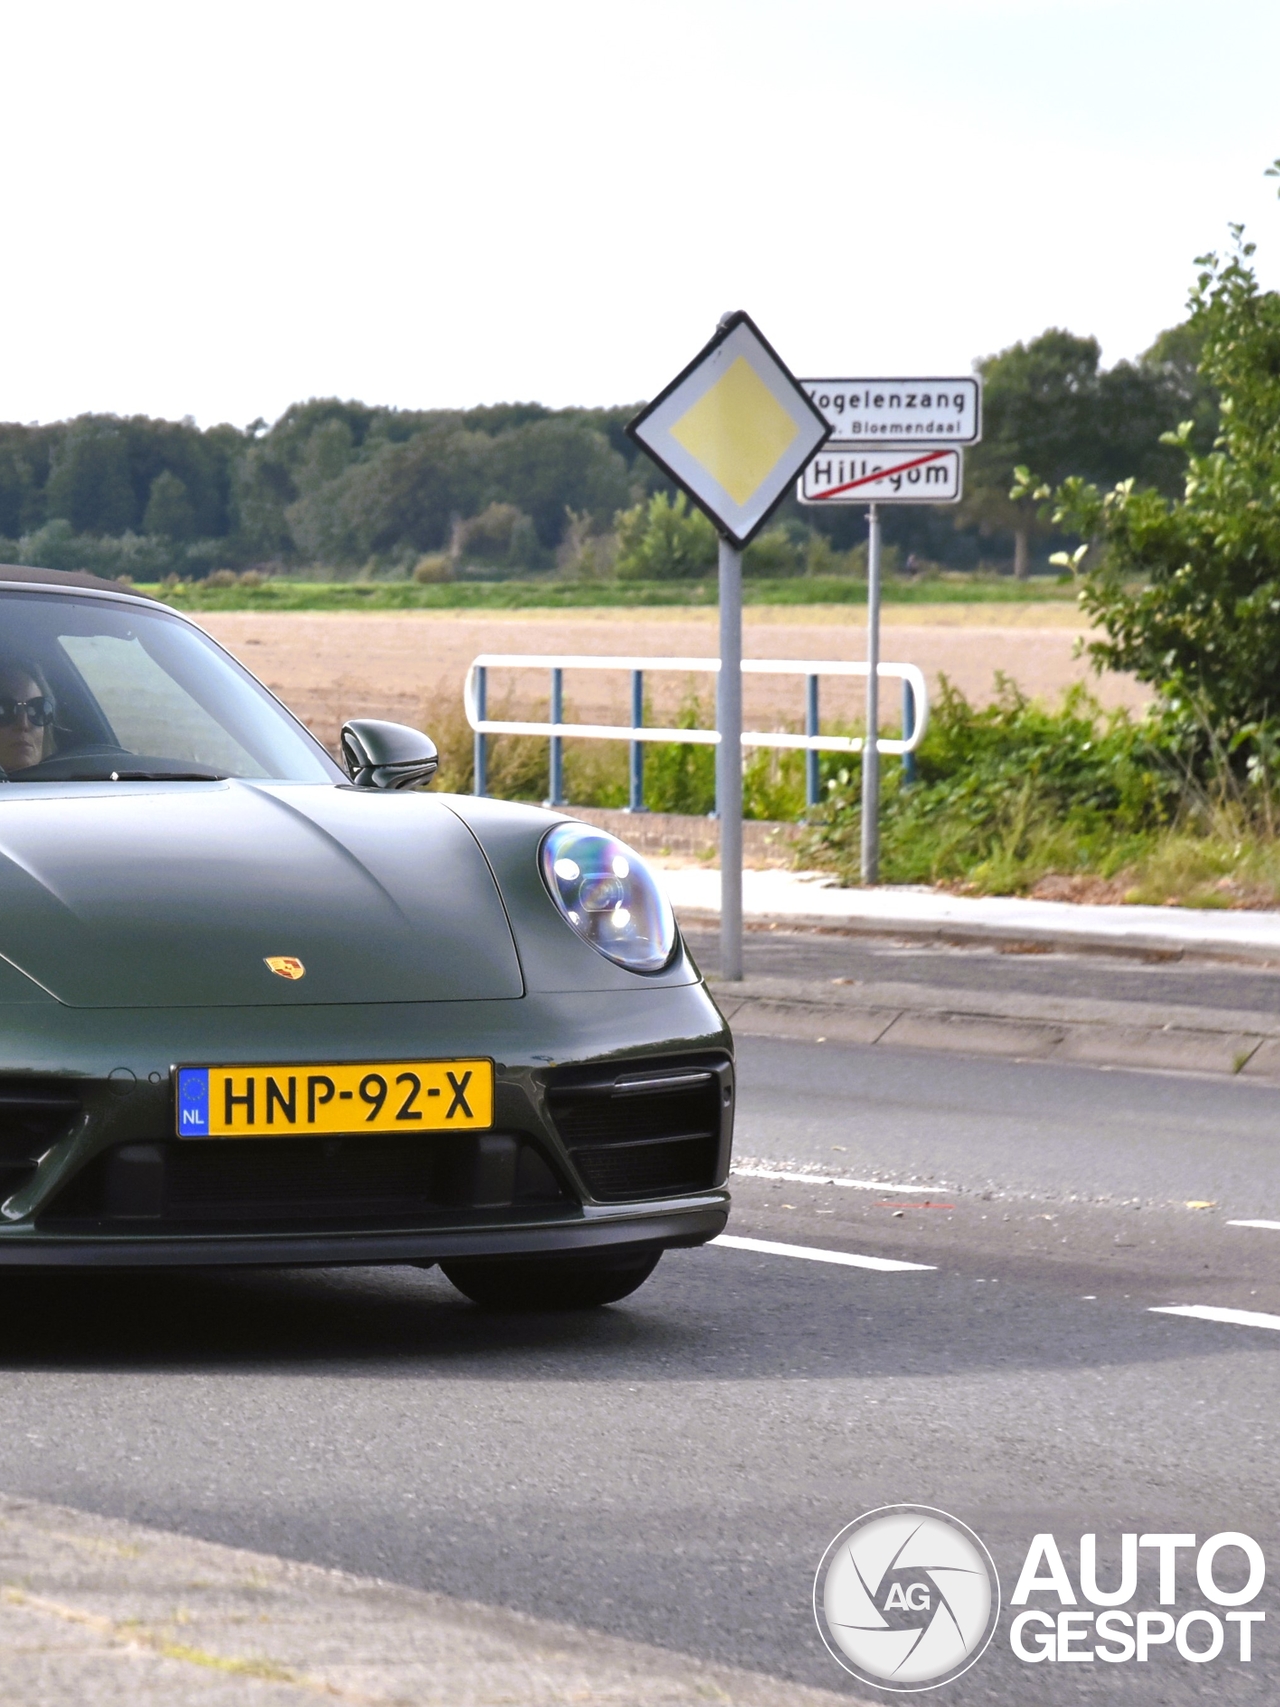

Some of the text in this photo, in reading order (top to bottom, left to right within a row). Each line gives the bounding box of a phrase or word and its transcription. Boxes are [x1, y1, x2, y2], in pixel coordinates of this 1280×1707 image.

[852, 421, 962, 434] Bloemendaal
[224, 1070, 474, 1125] HNP-92-X
[183, 1109, 205, 1125] NL
